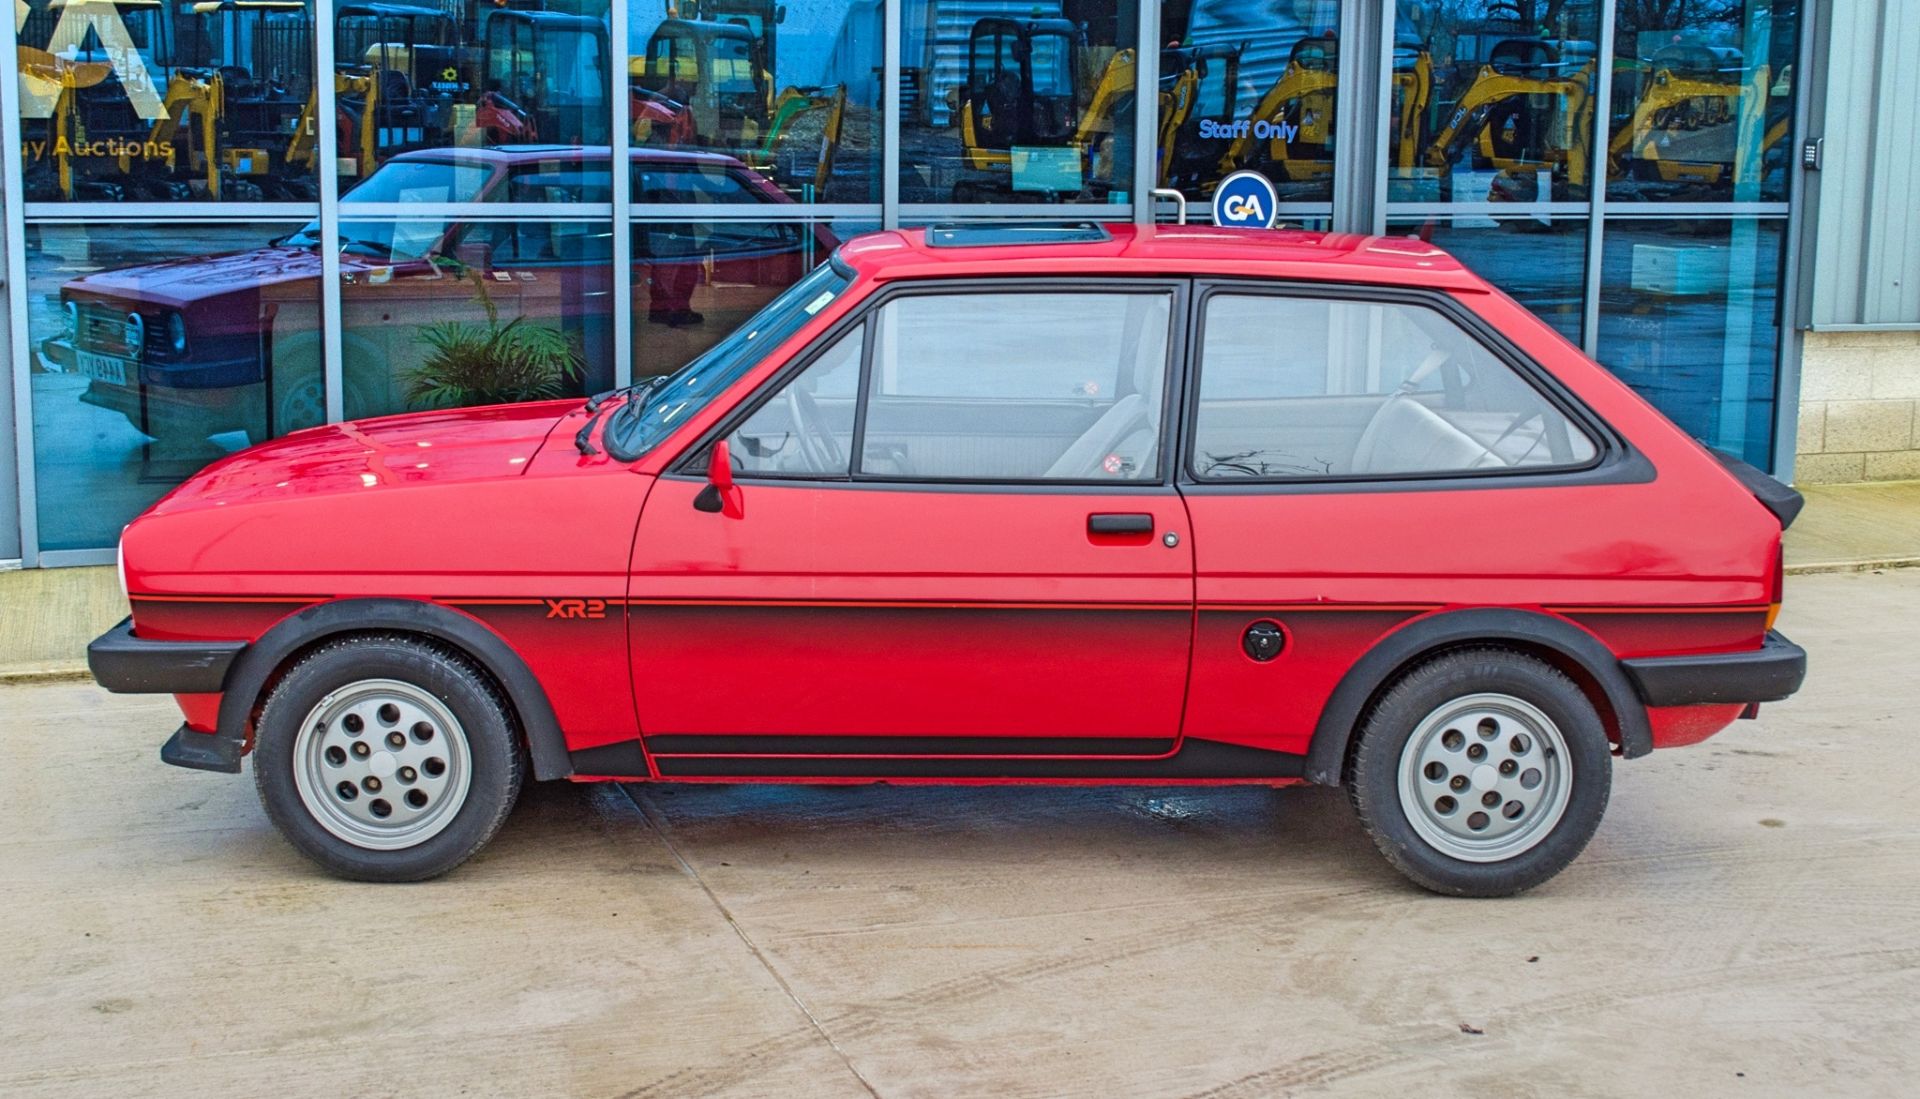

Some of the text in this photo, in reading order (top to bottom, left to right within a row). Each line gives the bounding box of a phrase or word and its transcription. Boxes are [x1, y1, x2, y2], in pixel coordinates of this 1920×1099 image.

[1199, 119, 1298, 143] Staff Only
[53, 136, 174, 157] Auctions
[1223, 194, 1265, 221] GA
[546, 599, 606, 618] XR2
